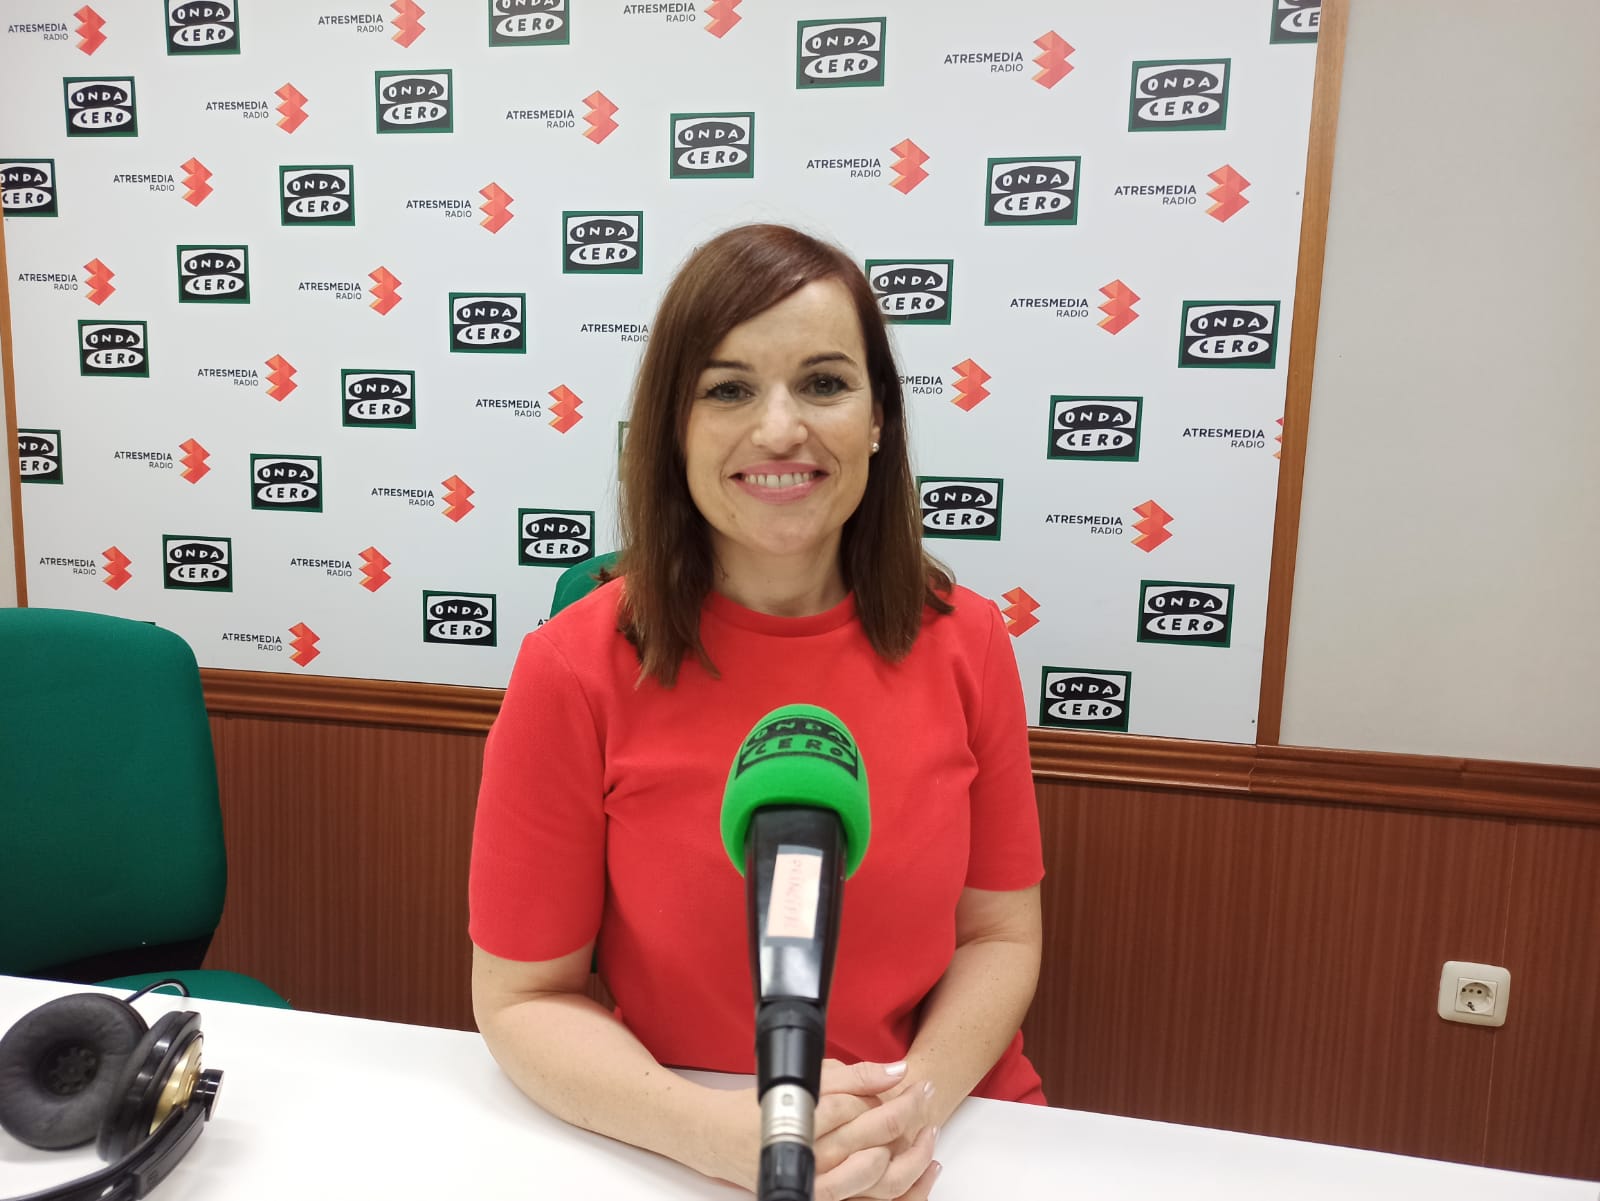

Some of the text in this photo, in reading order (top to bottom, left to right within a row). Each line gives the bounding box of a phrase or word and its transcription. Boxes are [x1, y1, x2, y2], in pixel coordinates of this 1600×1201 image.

[177, 7, 225, 20] ONDA
[623, 2, 696, 15] ATRESMEDIA
[318, 13, 384, 25] ATRESMEDIA
[665, 13, 696, 23] RADIO
[1293, 11, 1320, 27] CE
[7, 23, 68, 33] ATRESMEDIA
[356, 24, 384, 33] RADIO
[505, 18, 554, 32] CERO
[43, 32, 69, 41] RADIO
[180, 28, 226, 42] CERO
[812, 35, 868, 49] ONDA
[943, 51, 1024, 65] ATRESMEDIA
[815, 59, 868, 73] CERO
[990, 63, 1024, 73] RADIO
[1148, 77, 1210, 91] ONDA
[76, 91, 123, 103] ONDA
[388, 85, 438, 98] ONDA
[205, 100, 269, 111] ATRESMEDIA
[1150, 101, 1209, 116] CERO
[80, 111, 124, 124] CERO
[242, 110, 269, 119] RADIO
[391, 106, 439, 120] CERO
[505, 109, 575, 120] ATRESMEDIA
[546, 120, 576, 129] RADIO
[684, 128, 739, 142] ONDA
[688, 151, 738, 164] CERO
[806, 158, 881, 169] ATRESMEDIA
[113, 174, 175, 183] ATRESMEDIA
[850, 169, 882, 178] RADIO
[292, 179, 340, 192] ONDA
[1002, 173, 1062, 187] ONDA
[149, 184, 175, 192] RADIO
[1114, 184, 1197, 196] ATRESMEDIA
[1, 192, 44, 205] CERO
[405, 199, 472, 209] ATRESMEDIA
[1005, 197, 1060, 210] CERO
[1162, 196, 1197, 205] RADIO
[295, 200, 341, 213] CERO
[444, 210, 473, 218] RADIO
[575, 226, 628, 238] ONDA
[578, 247, 628, 261] CERO
[189, 259, 236, 270] ONDA
[18, 273, 78, 283] ATRESMEDIA
[879, 275, 936, 288] ONDA
[53, 283, 79, 291] RADIO
[192, 278, 237, 291] CERO
[298, 282, 362, 291] ATRESMEDIA
[335, 292, 362, 300] RADIO
[882, 297, 935, 310] CERO
[1010, 298, 1089, 308] ATRESMEDIA
[462, 307, 512, 319] ONDA
[1056, 309, 1089, 318] RADIO
[580, 323, 649, 334] ATRESMEDIA
[1197, 316, 1260, 330] ONDA
[90, 334, 135, 345] ONDA
[465, 327, 512, 340] CERO
[620, 333, 650, 343] RADIO
[1200, 340, 1258, 353] CERO
[93, 352, 136, 365] CERO
[197, 368, 259, 378] ATRESMEDIA
[233, 378, 259, 387] RADIO
[898, 375, 943, 386] SMEDIA
[353, 383, 402, 395] ONDA
[912, 386, 943, 395] RADIO
[357, 403, 402, 415] CERO
[475, 398, 541, 409] ATRESMEDIA
[514, 409, 542, 418] RADIO
[1064, 411, 1124, 424] ONDA
[1182, 427, 1265, 439] ATRESMEDIA
[1066, 433, 1123, 447] CERO
[1230, 439, 1265, 449] RADIO
[17, 441, 50, 452] NDA
[113, 451, 173, 461] ATRESMEDIA
[20, 459, 50, 472] ERO
[148, 461, 174, 469] RADIO
[262, 467, 309, 479] ONDA
[265, 487, 310, 499] CERO
[371, 487, 435, 499] ATRESMEDIA
[929, 491, 986, 503] ONDA
[408, 498, 435, 507] RADIO
[931, 512, 986, 526] CERO
[1045, 514, 1123, 526] ATRESMEDIA
[531, 522, 581, 534] ONDA
[1090, 526, 1123, 535] RADIO
[174, 548, 219, 559] ONDA
[533, 542, 581, 555] CERO
[39, 557, 96, 568] ATRESMEDIA
[290, 557, 352, 569] ATRESMEDIA
[72, 567, 97, 576] RADIO
[177, 567, 220, 579] CERO
[326, 569, 353, 577] RADIO
[1155, 596, 1215, 609] ONDA
[435, 604, 483, 616] ONDA
[438, 623, 483, 636] CERO
[1157, 618, 1213, 631] CERO
[221, 632, 282, 644] ATRESMEDIA
[257, 643, 283, 652] RADIO
[1056, 682, 1114, 695] ONDA
[1059, 703, 1112, 716] CERO
[755, 722, 844, 741] ONDA
[755, 737, 844, 757] CERO
